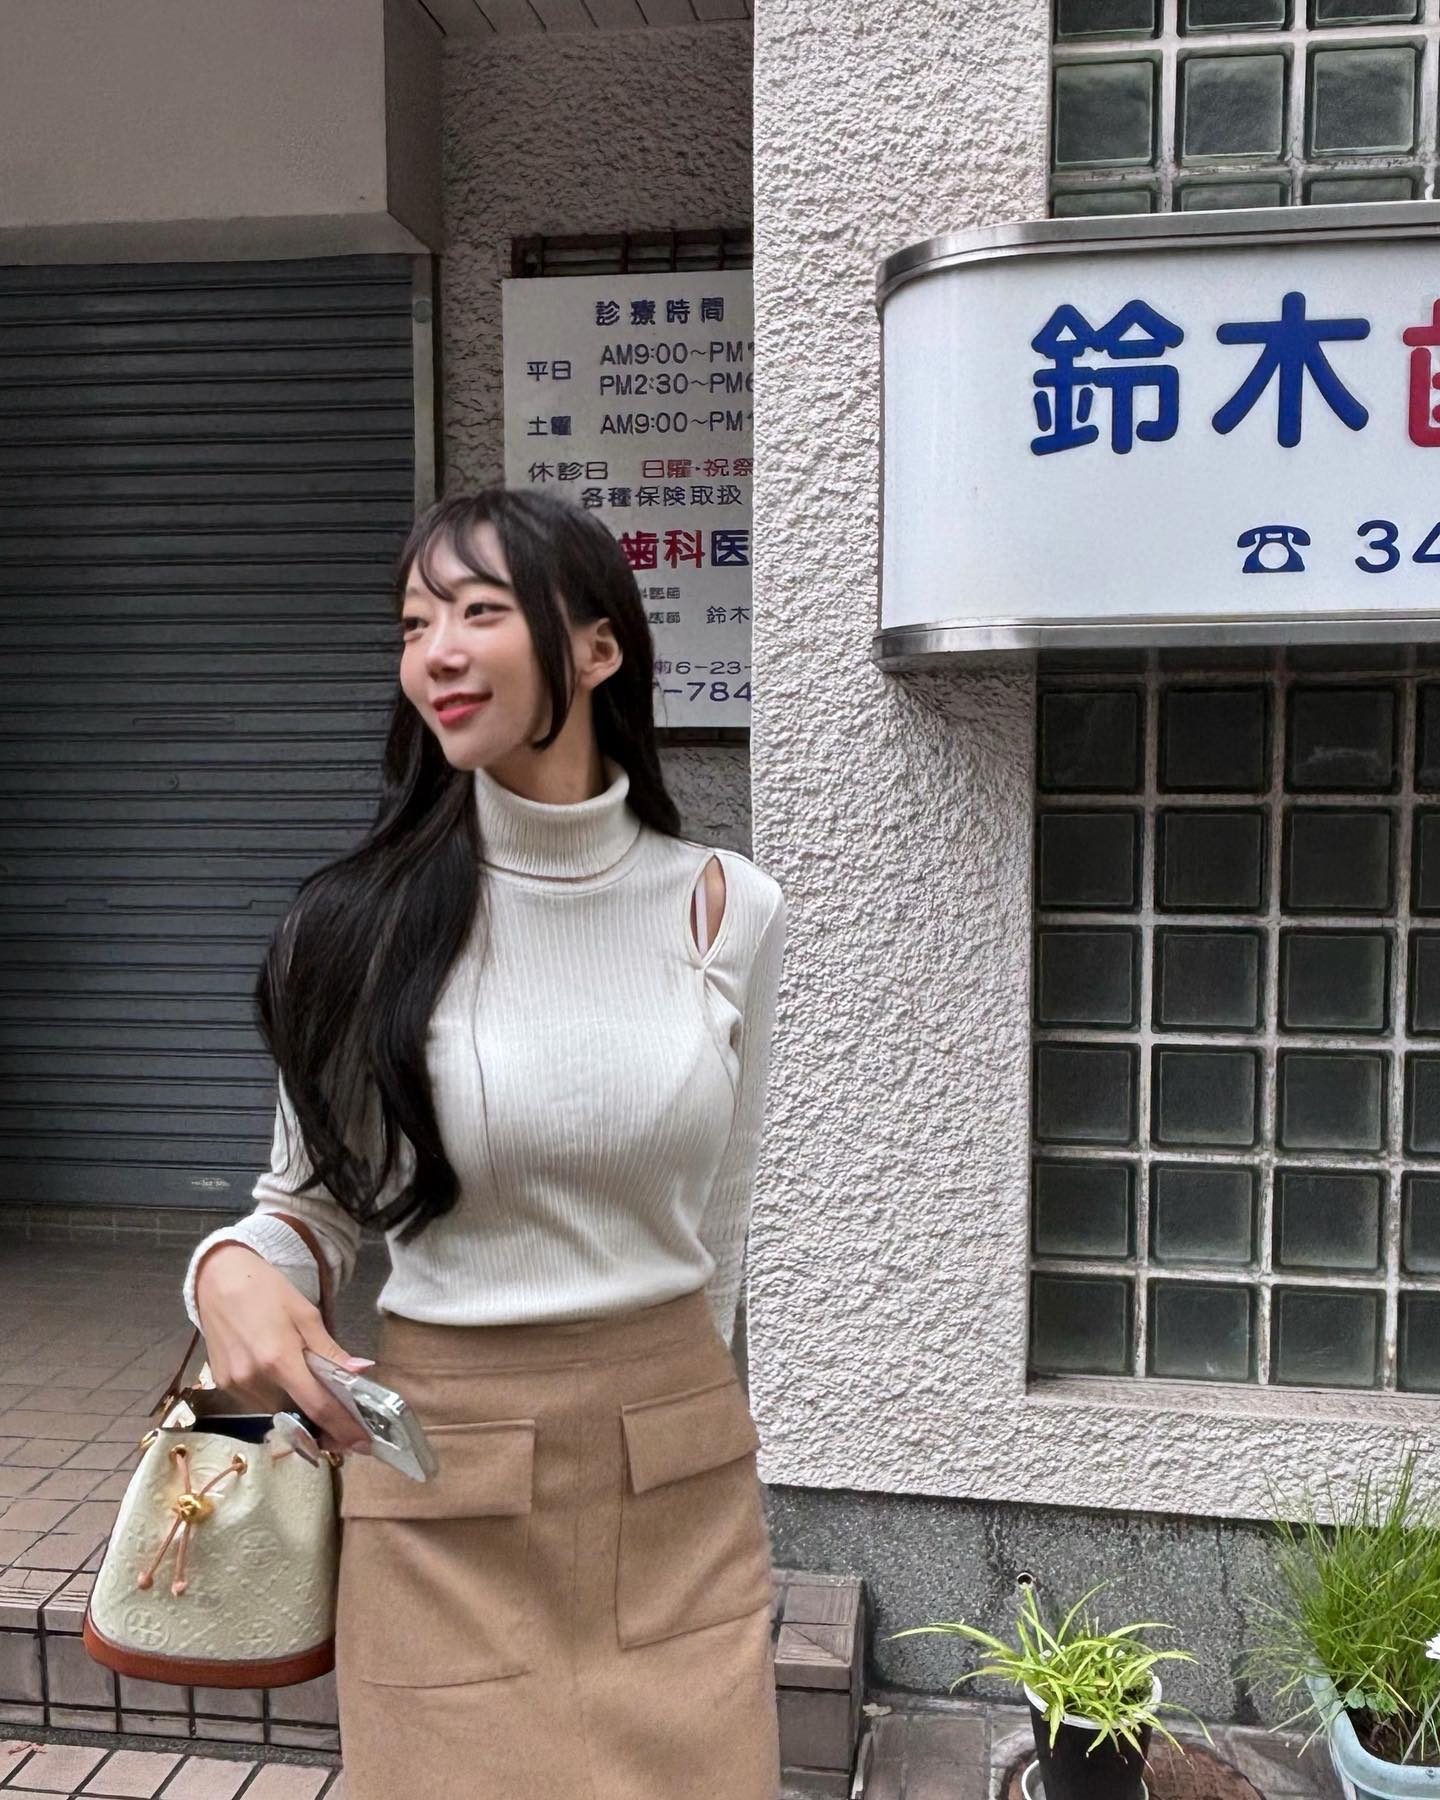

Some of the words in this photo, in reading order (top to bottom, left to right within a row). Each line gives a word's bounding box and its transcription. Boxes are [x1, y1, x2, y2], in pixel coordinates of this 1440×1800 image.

[595, 297, 724, 326] 診療時間
[527, 360, 572, 382] 平日
[1030, 291, 1440, 456] 鈴木
[528, 461, 608, 483] 休診日
[582, 485, 743, 508] 各種保険取扱
[619, 530, 750, 570] 歯科医
[706, 605, 750, 624] 鈴木
